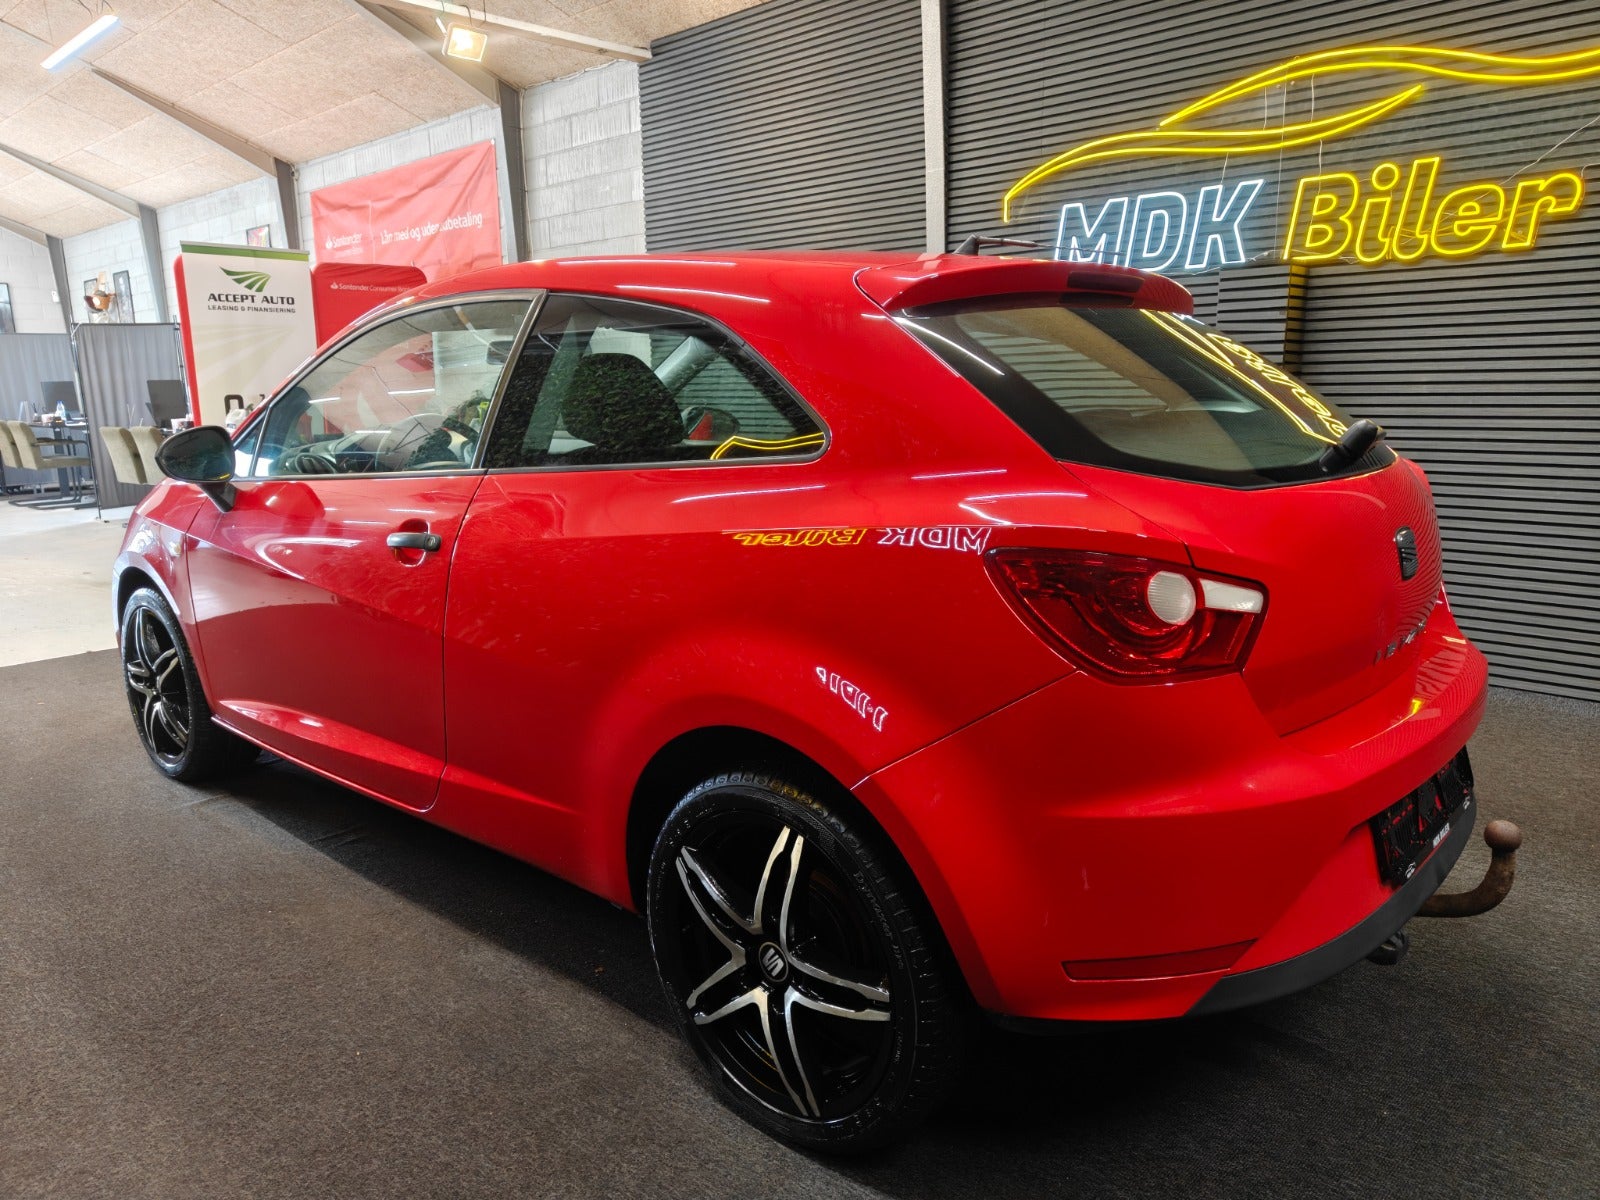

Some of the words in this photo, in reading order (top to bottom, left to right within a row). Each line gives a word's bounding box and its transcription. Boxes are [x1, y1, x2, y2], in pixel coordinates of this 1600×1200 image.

[1054, 179, 1264, 272] MDK
[1281, 156, 1584, 265] Biler
[333, 232, 362, 249] Santander
[380, 229, 392, 245] Lån
[394, 226, 409, 241] med
[410, 227, 421, 241] og
[339, 283, 368, 291] Santander
[207, 293, 256, 303] ACCEPT
[261, 295, 295, 305] AUTO
